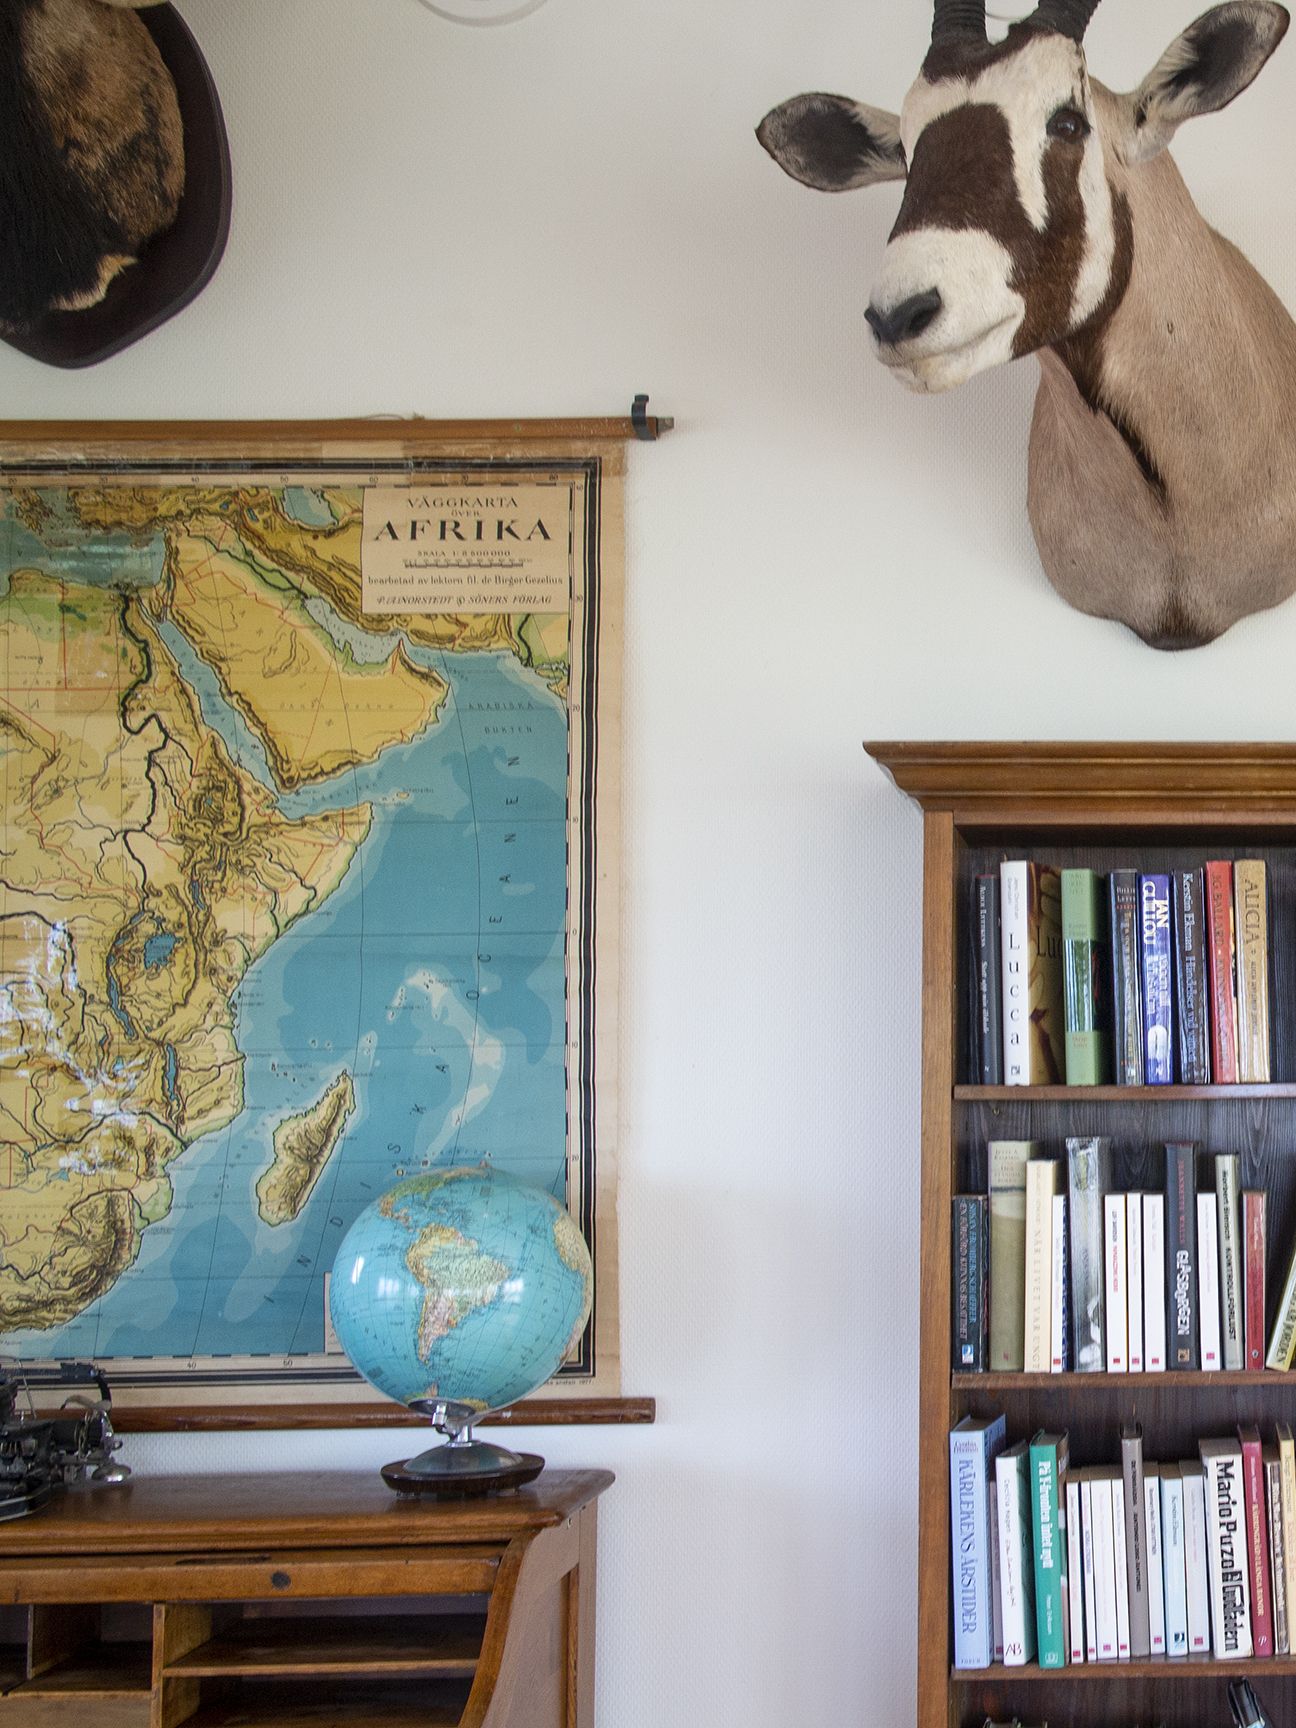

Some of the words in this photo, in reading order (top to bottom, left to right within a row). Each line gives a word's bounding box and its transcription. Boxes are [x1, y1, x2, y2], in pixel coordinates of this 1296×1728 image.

[406, 496, 519, 509] VÄGGKARTA
[374, 518, 552, 541] AFRIKA
[368, 576, 415, 585] bearbetad
[430, 576, 464, 585] lektorn
[494, 575, 524, 587] Birger
[512, 594, 552, 605] FÖRLAG
[1182, 873, 1194, 910] Kerstin
[1143, 881, 1156, 944] GUILLOU
[1156, 900, 1169, 928] JAN
[1184, 913, 1195, 951] Ekman
[1244, 879, 1260, 945] ALICIA
[1008, 932, 1021, 1045] Lucca
[1276, 1322, 1296, 1365] JORDEN
[1038, 1460, 1053, 1477] På
[958, 1459, 977, 1554] KÄRLEKENS
[1216, 1460, 1238, 1518] Mario
[1219, 1519, 1238, 1570] Puzo
[960, 1557, 978, 1634] ÅRSTIDER
